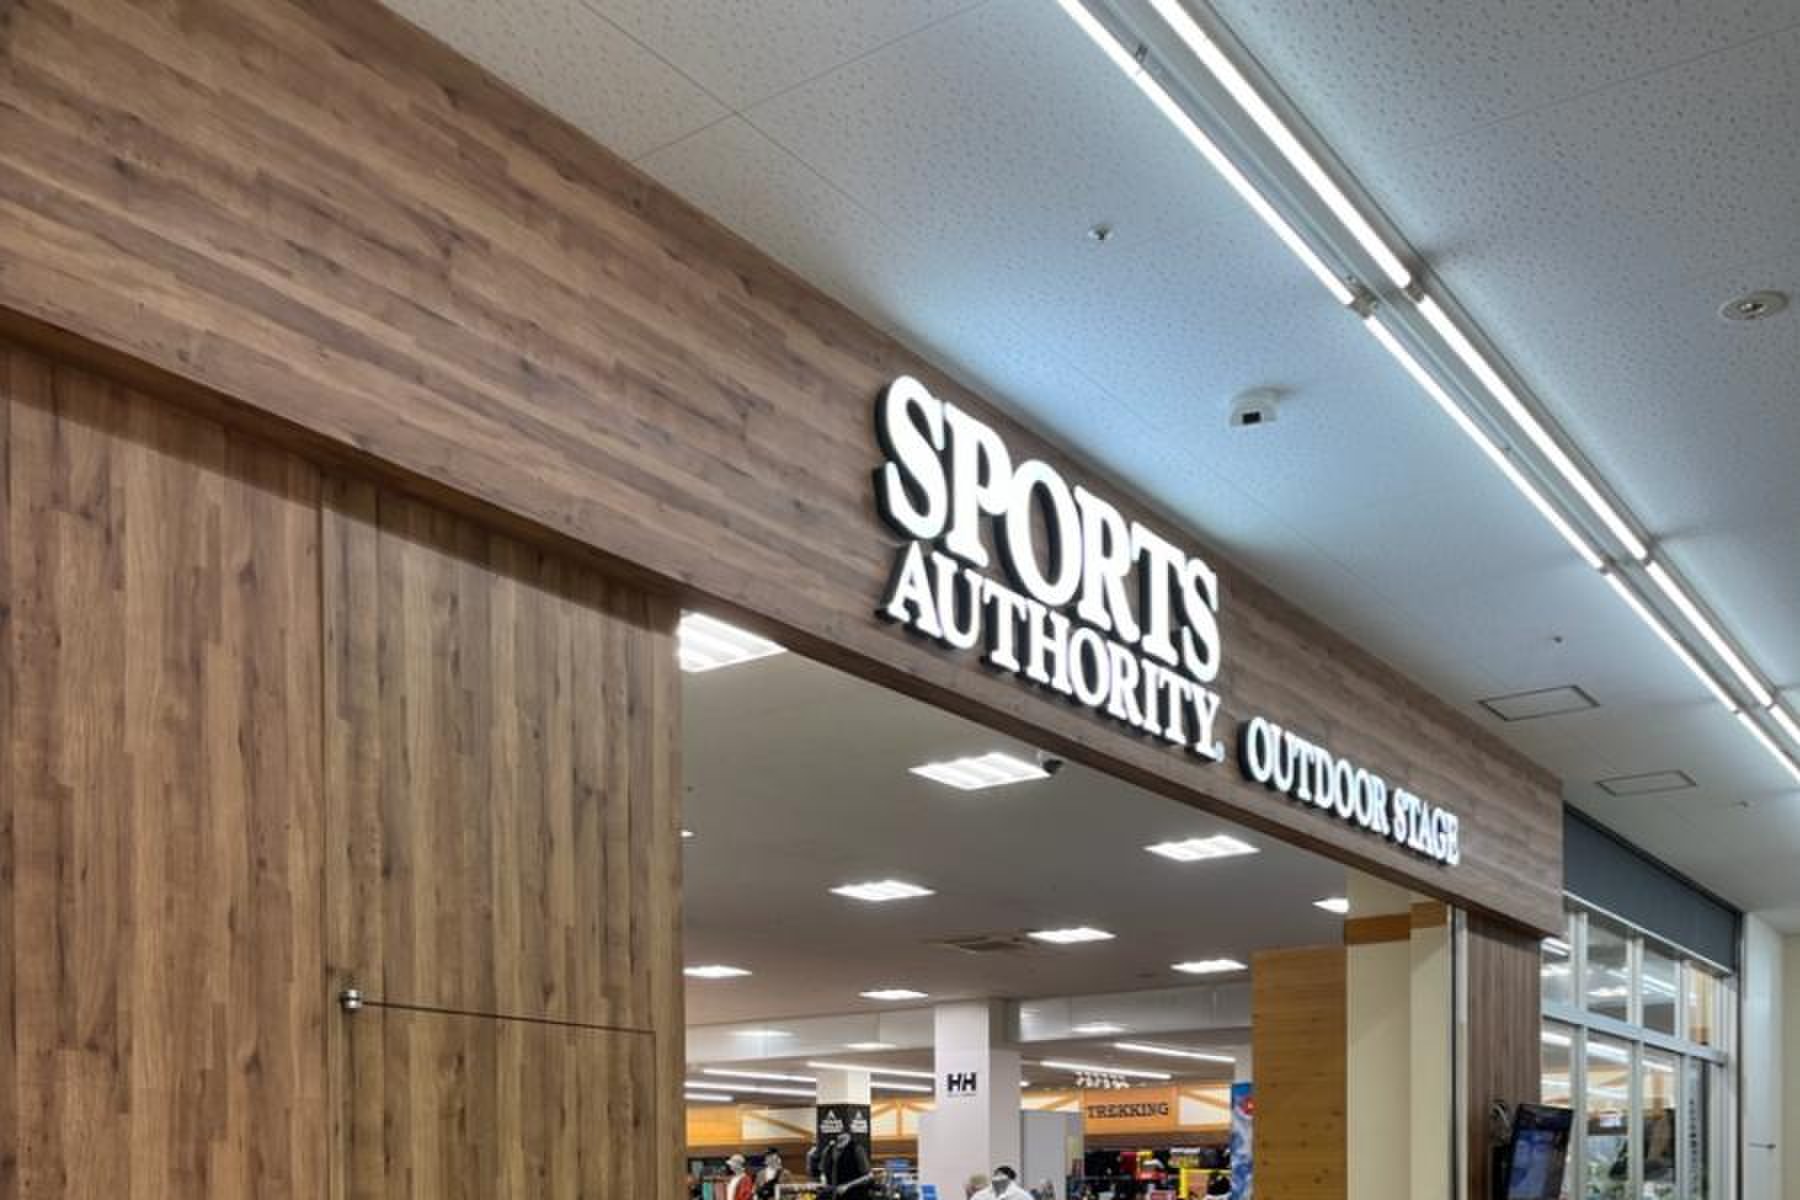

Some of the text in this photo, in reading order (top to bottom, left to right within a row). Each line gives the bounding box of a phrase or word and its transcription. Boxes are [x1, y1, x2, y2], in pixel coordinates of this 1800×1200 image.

[885, 374, 1221, 683] SPORTS
[1247, 716, 1460, 867] OUTDOOR STAGE
[947, 1072, 977, 1092] HH
[1087, 1102, 1169, 1119] TREKKING
